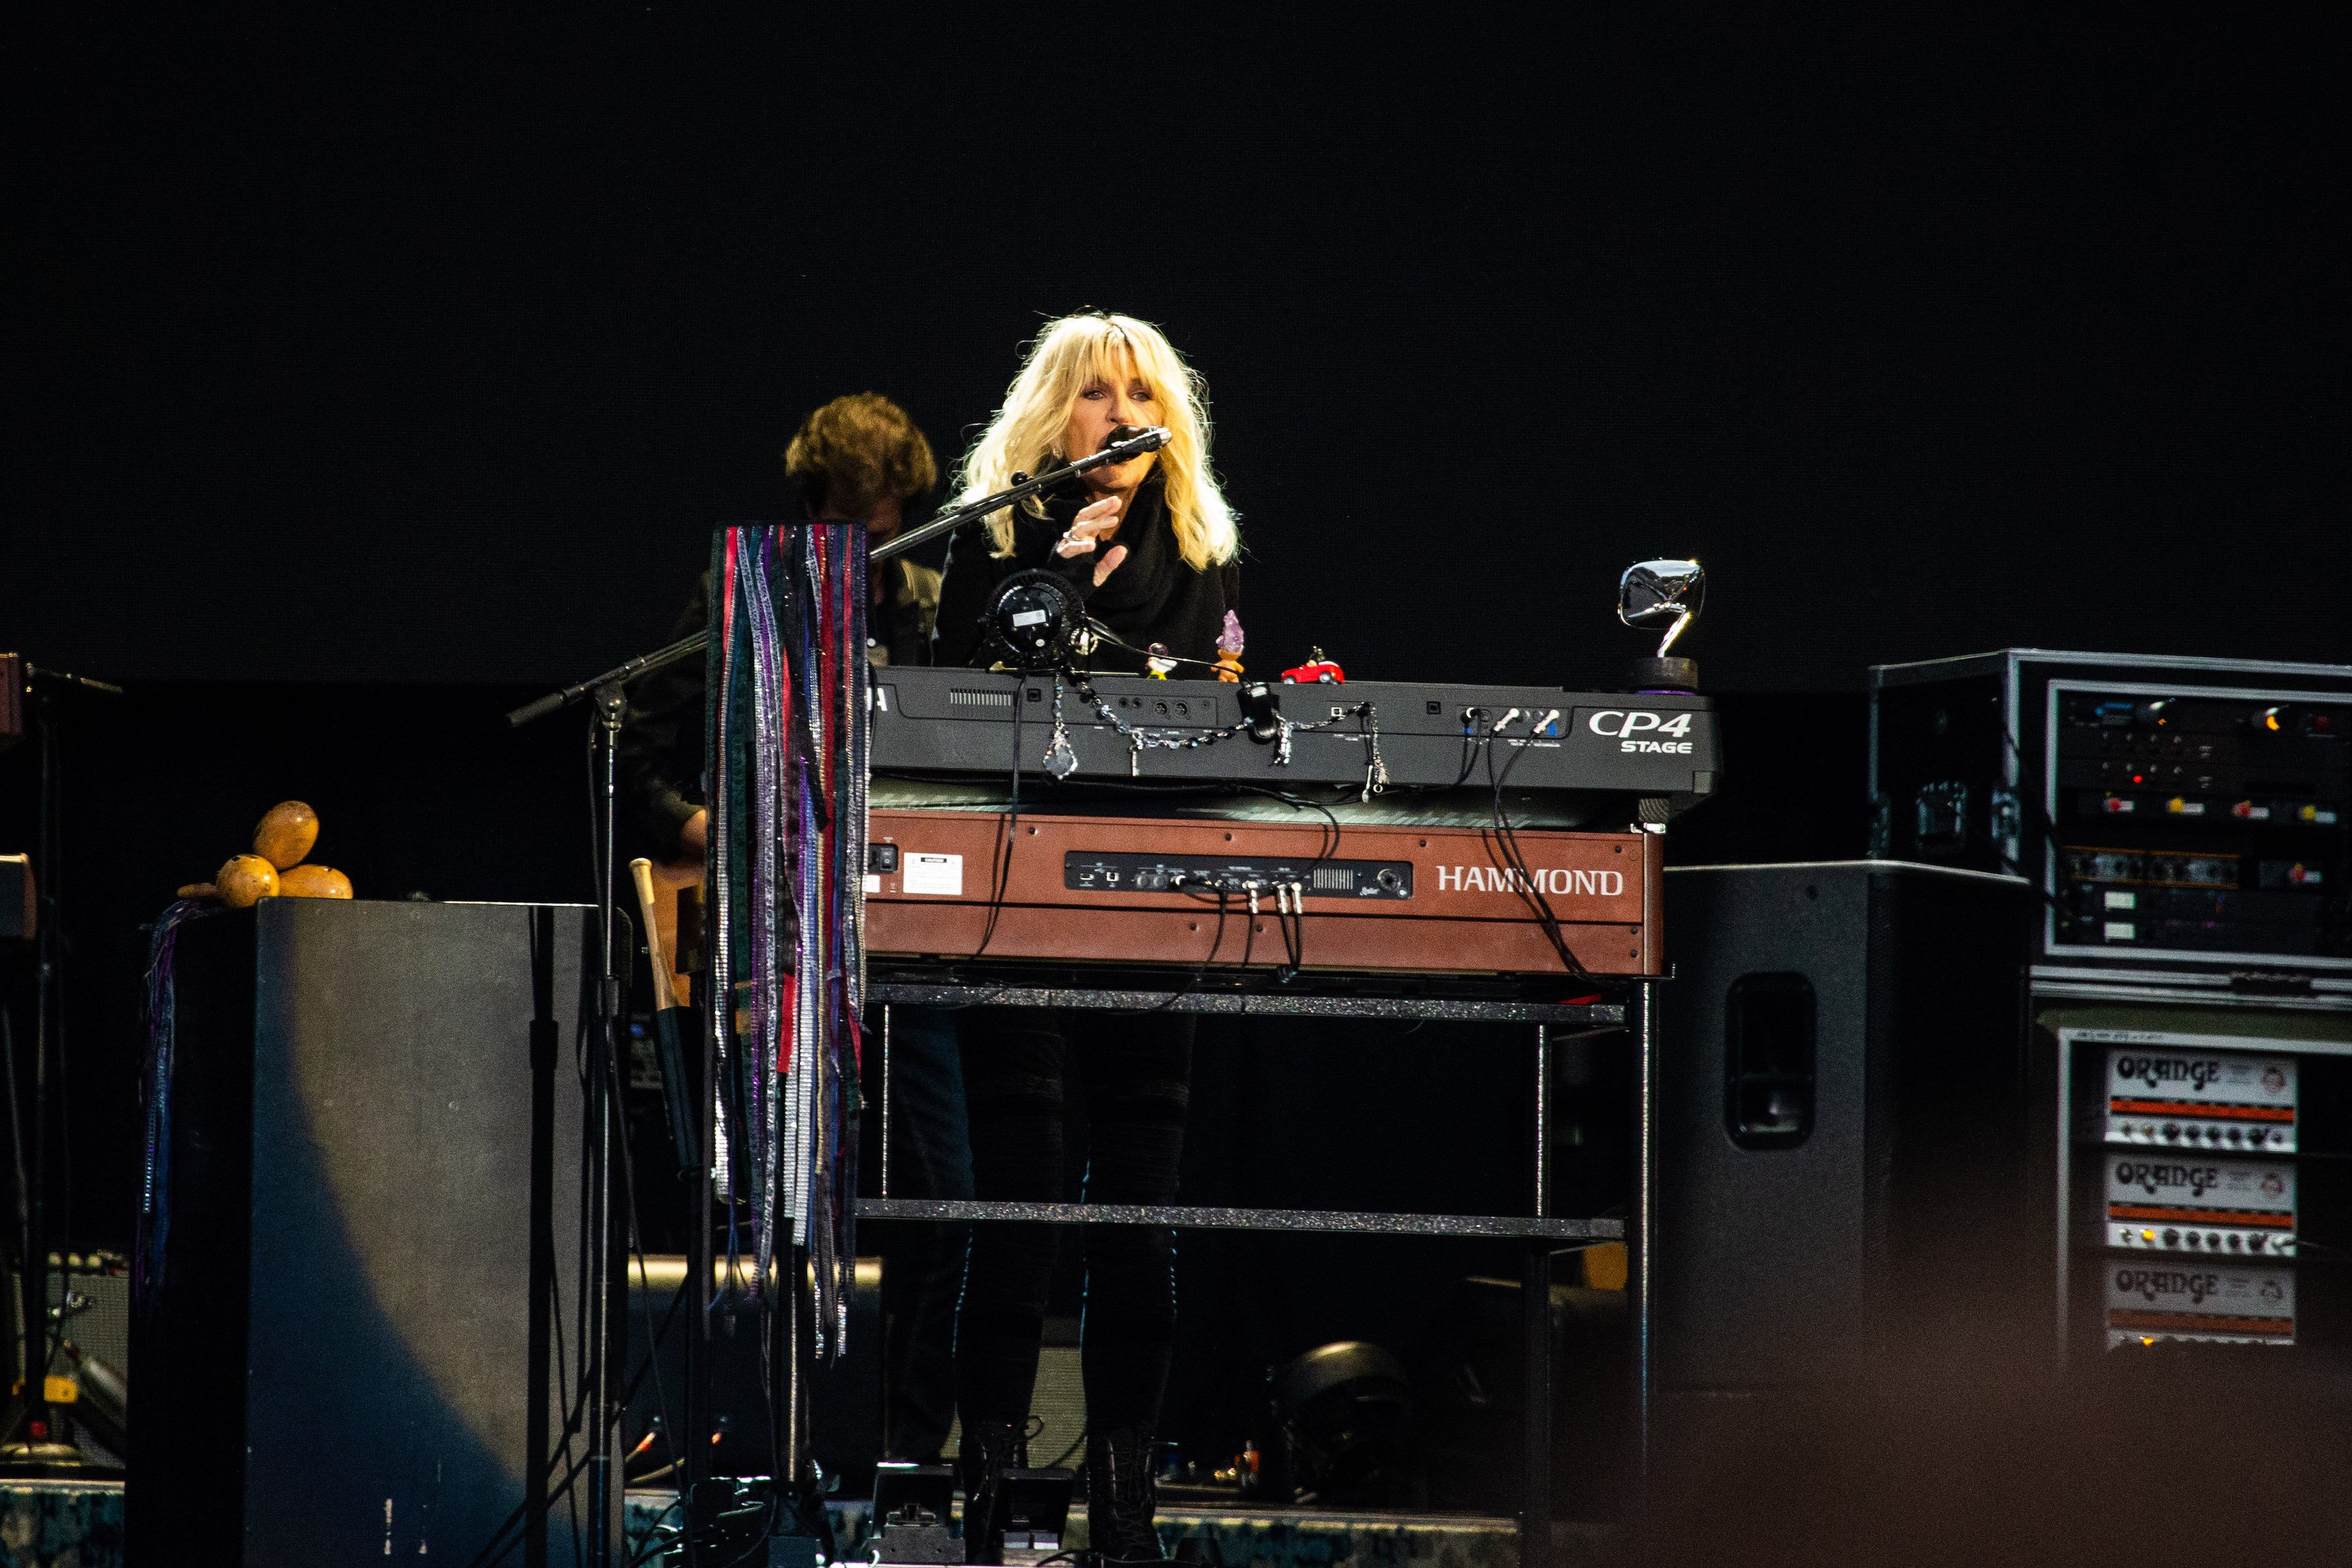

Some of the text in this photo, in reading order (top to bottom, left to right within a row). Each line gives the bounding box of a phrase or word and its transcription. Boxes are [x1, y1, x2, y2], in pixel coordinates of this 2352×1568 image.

[1589, 711, 1692, 738] CP4
[1620, 740, 1693, 755] STAGE
[1435, 865, 1624, 896] HAMMOND
[2117, 1056, 2221, 1091] ORANGE
[2116, 1162, 2219, 1198] ORANGE
